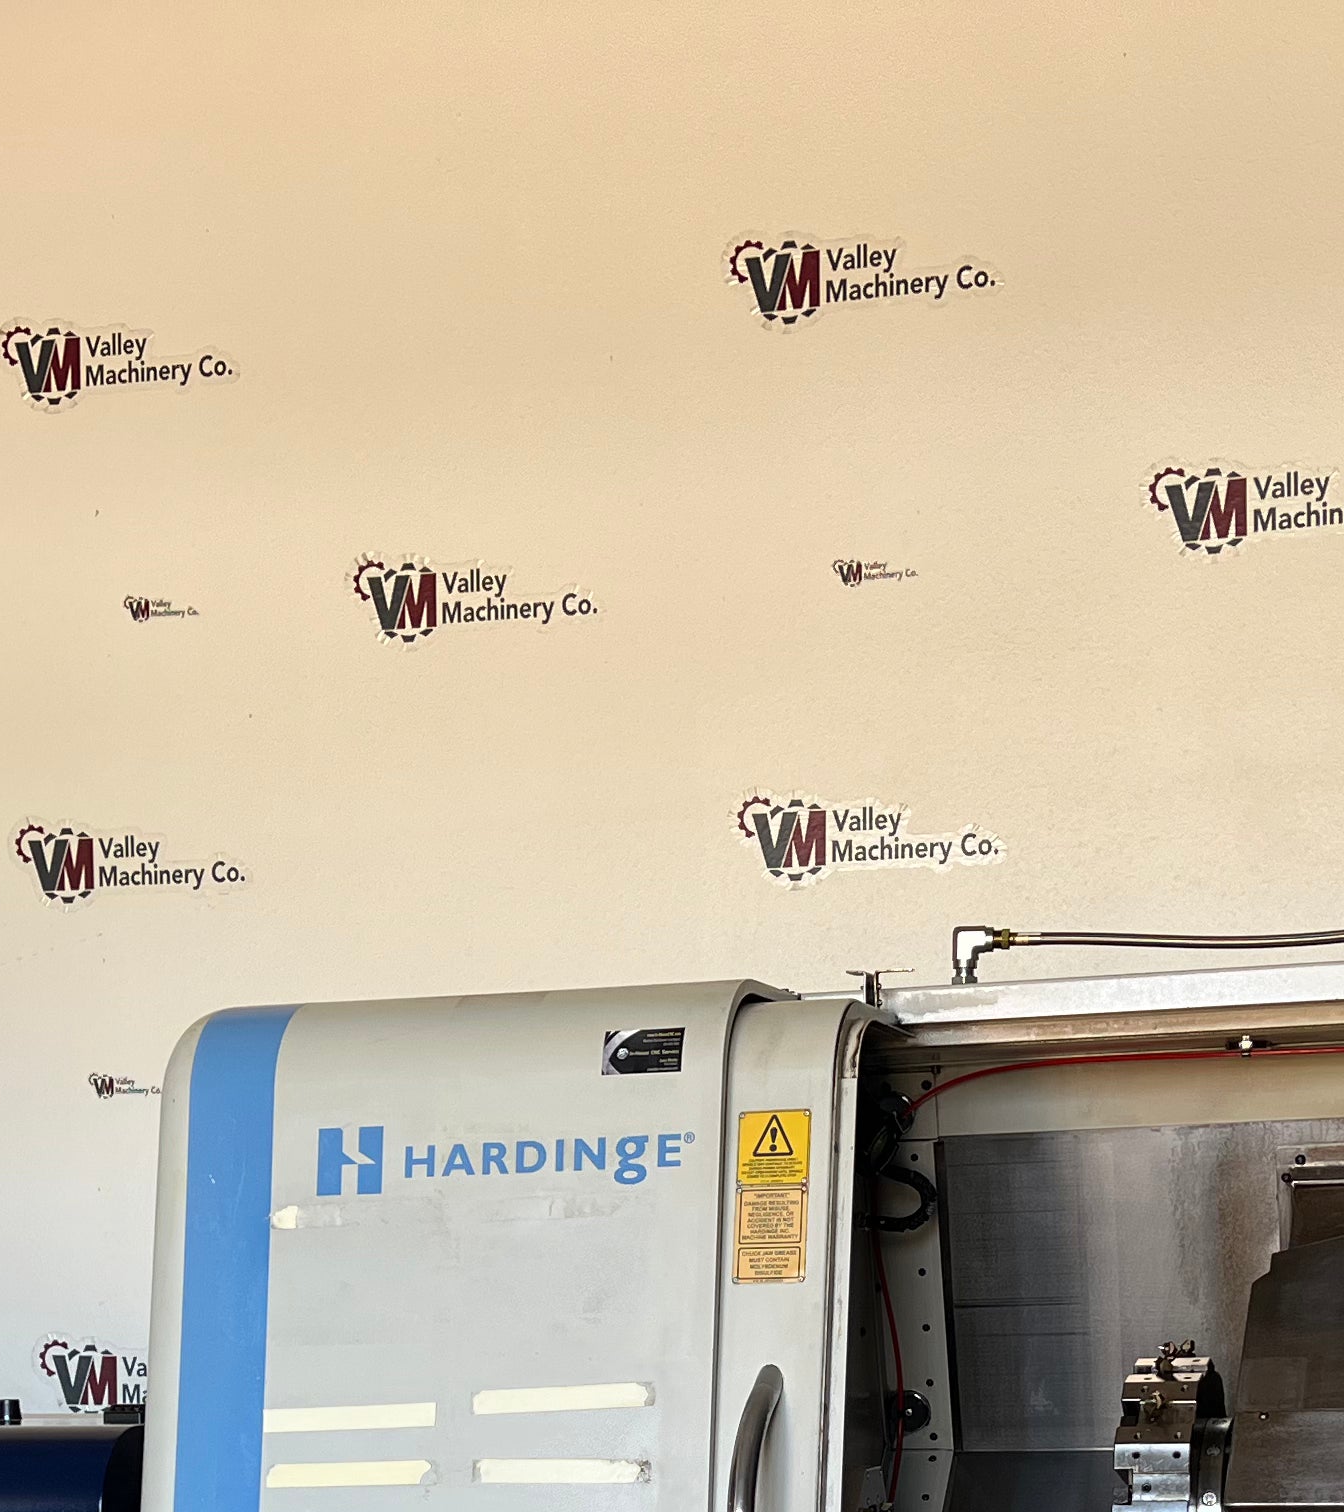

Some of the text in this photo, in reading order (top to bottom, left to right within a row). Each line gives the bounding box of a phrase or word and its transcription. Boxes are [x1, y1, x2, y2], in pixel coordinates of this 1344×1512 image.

[826, 243, 897, 279] Valley
[744, 247, 820, 313] VM
[826, 265, 995, 303] Machinery Co.
[14, 336, 81, 394] VM
[85, 332, 147, 366] Valley
[86, 355, 232, 387] Machinery Co.
[1253, 471, 1330, 502] Valley
[1164, 477, 1247, 543] VM
[442, 568, 507, 598] Valley
[367, 573, 437, 632] VM
[442, 593, 598, 625] Machinery Co.
[752, 809, 826, 869] VM
[832, 806, 902, 837] Valley
[28, 838, 95, 892] VM
[98, 835, 160, 863] Valley
[832, 833, 999, 865] Machinery Co.
[99, 861, 245, 890] Machinery Co.
[52, 1355, 118, 1405] VM
